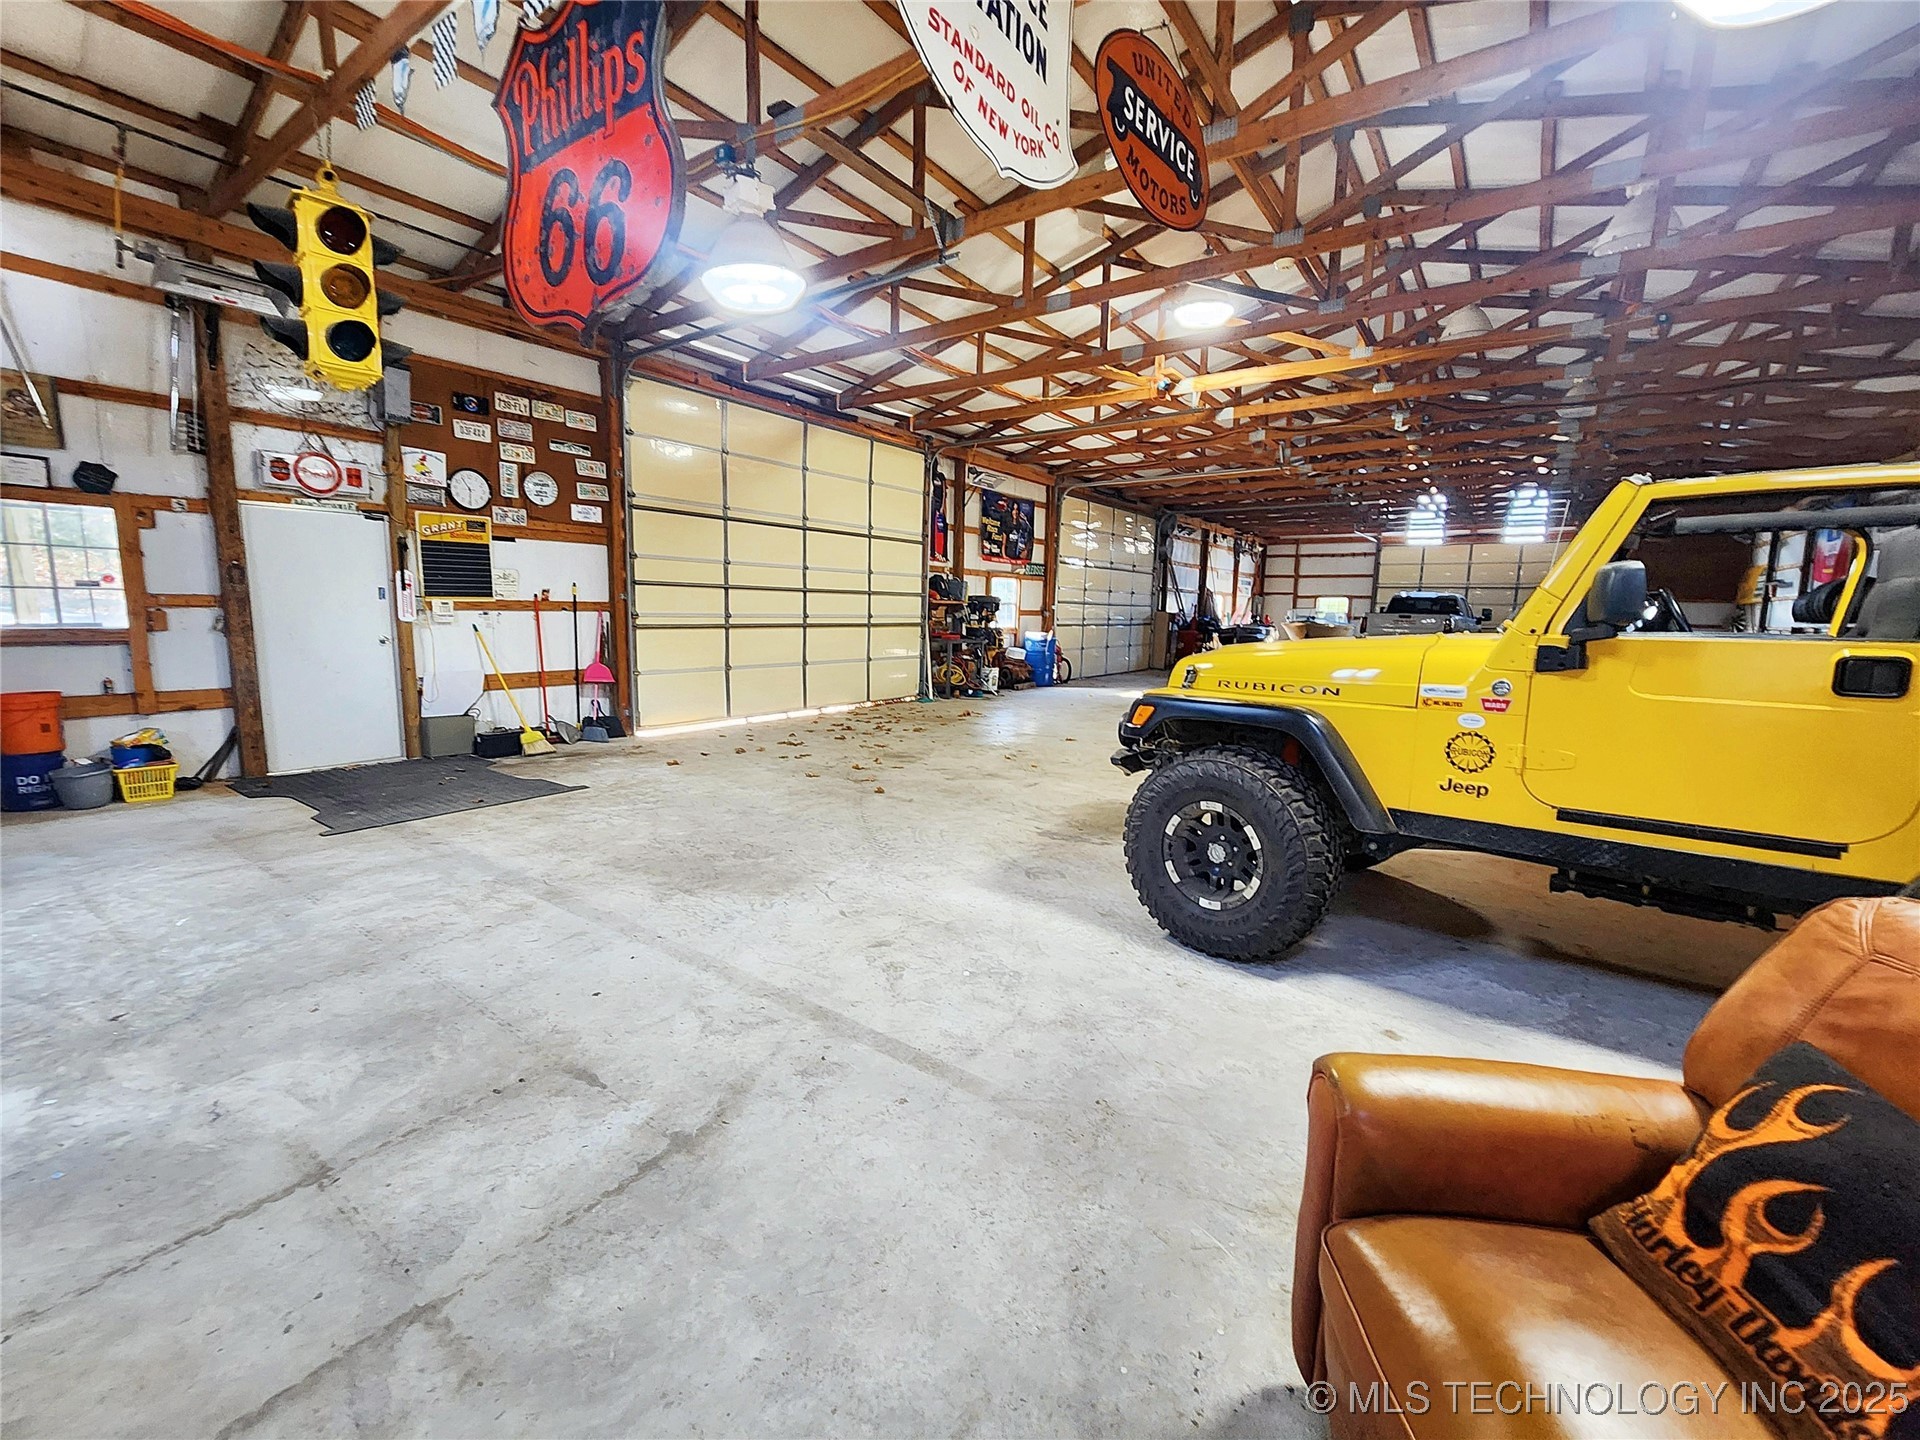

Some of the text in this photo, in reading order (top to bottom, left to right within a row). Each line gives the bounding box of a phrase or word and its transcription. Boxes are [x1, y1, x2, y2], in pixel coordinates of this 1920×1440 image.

[513, 18, 646, 156] Phillips
[928, 7, 1015, 104] STANDARD
[1021, 97, 1042, 132] OIL
[1132, 51, 1193, 129] UNITED
[953, 60, 1047, 158] OF NEW YORK
[1123, 85, 1195, 182] SERVICE
[1126, 143, 1188, 217] MOTORS
[538, 157, 632, 288] 66
[422, 520, 465, 536] GRANT
[1217, 679, 1340, 696] RUBICON
[16, 775, 39, 786] DO
[1439, 778, 1489, 798] Jeep
[1450, 746, 1490, 759] RUBICON
